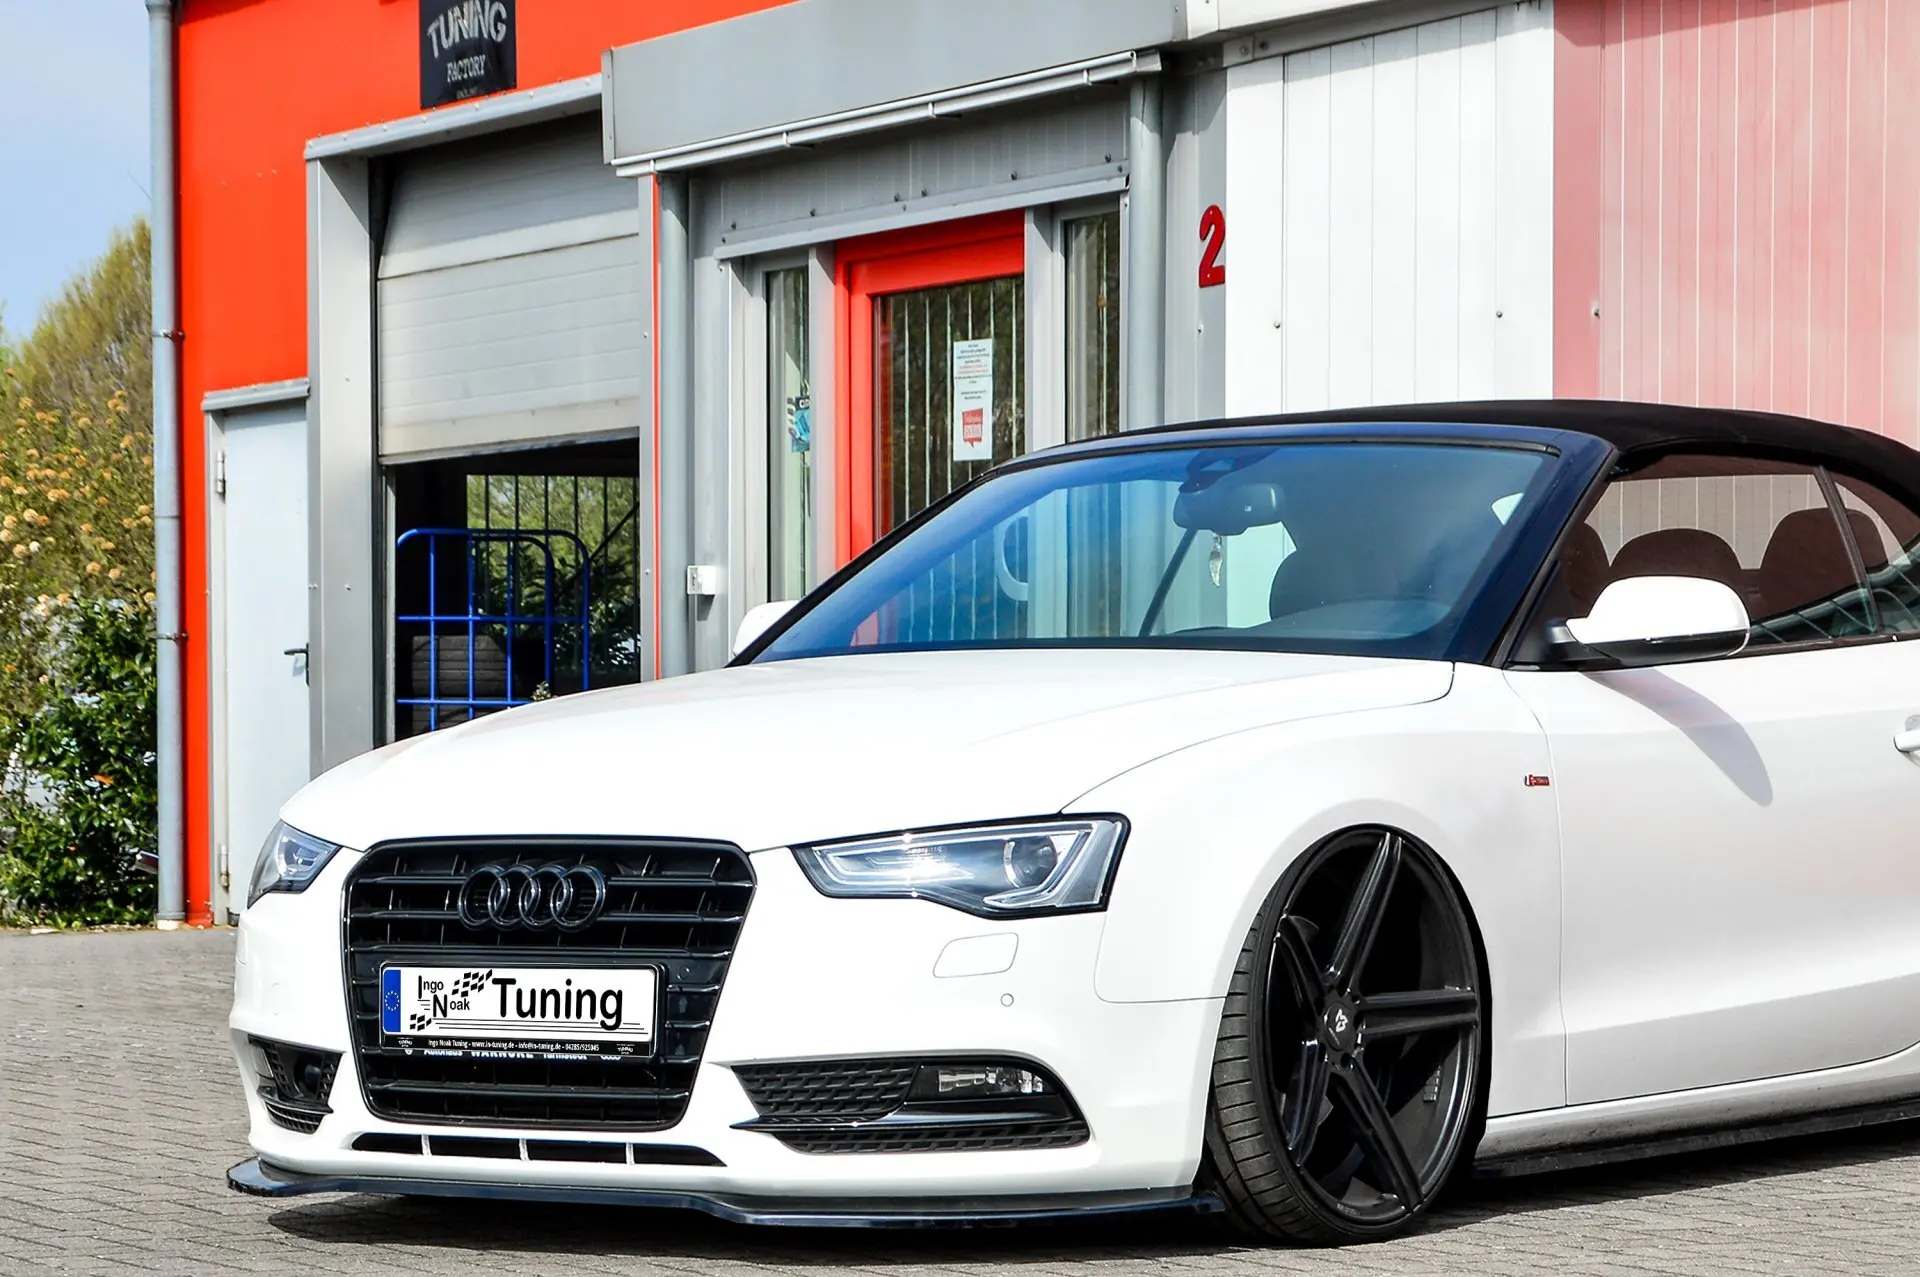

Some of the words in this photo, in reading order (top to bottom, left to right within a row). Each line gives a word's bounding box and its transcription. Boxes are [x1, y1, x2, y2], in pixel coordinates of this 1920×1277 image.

[426, 0, 507, 59] TUNING
[447, 54, 486, 83] FACTORY
[1199, 204, 1226, 288] 2
[418, 975, 444, 1000] Ingo
[433, 994, 470, 1018] Noak
[491, 977, 623, 1031] Tuning
[428, 1040, 439, 1048] Ingo
[452, 1040, 468, 1049] Tuning
